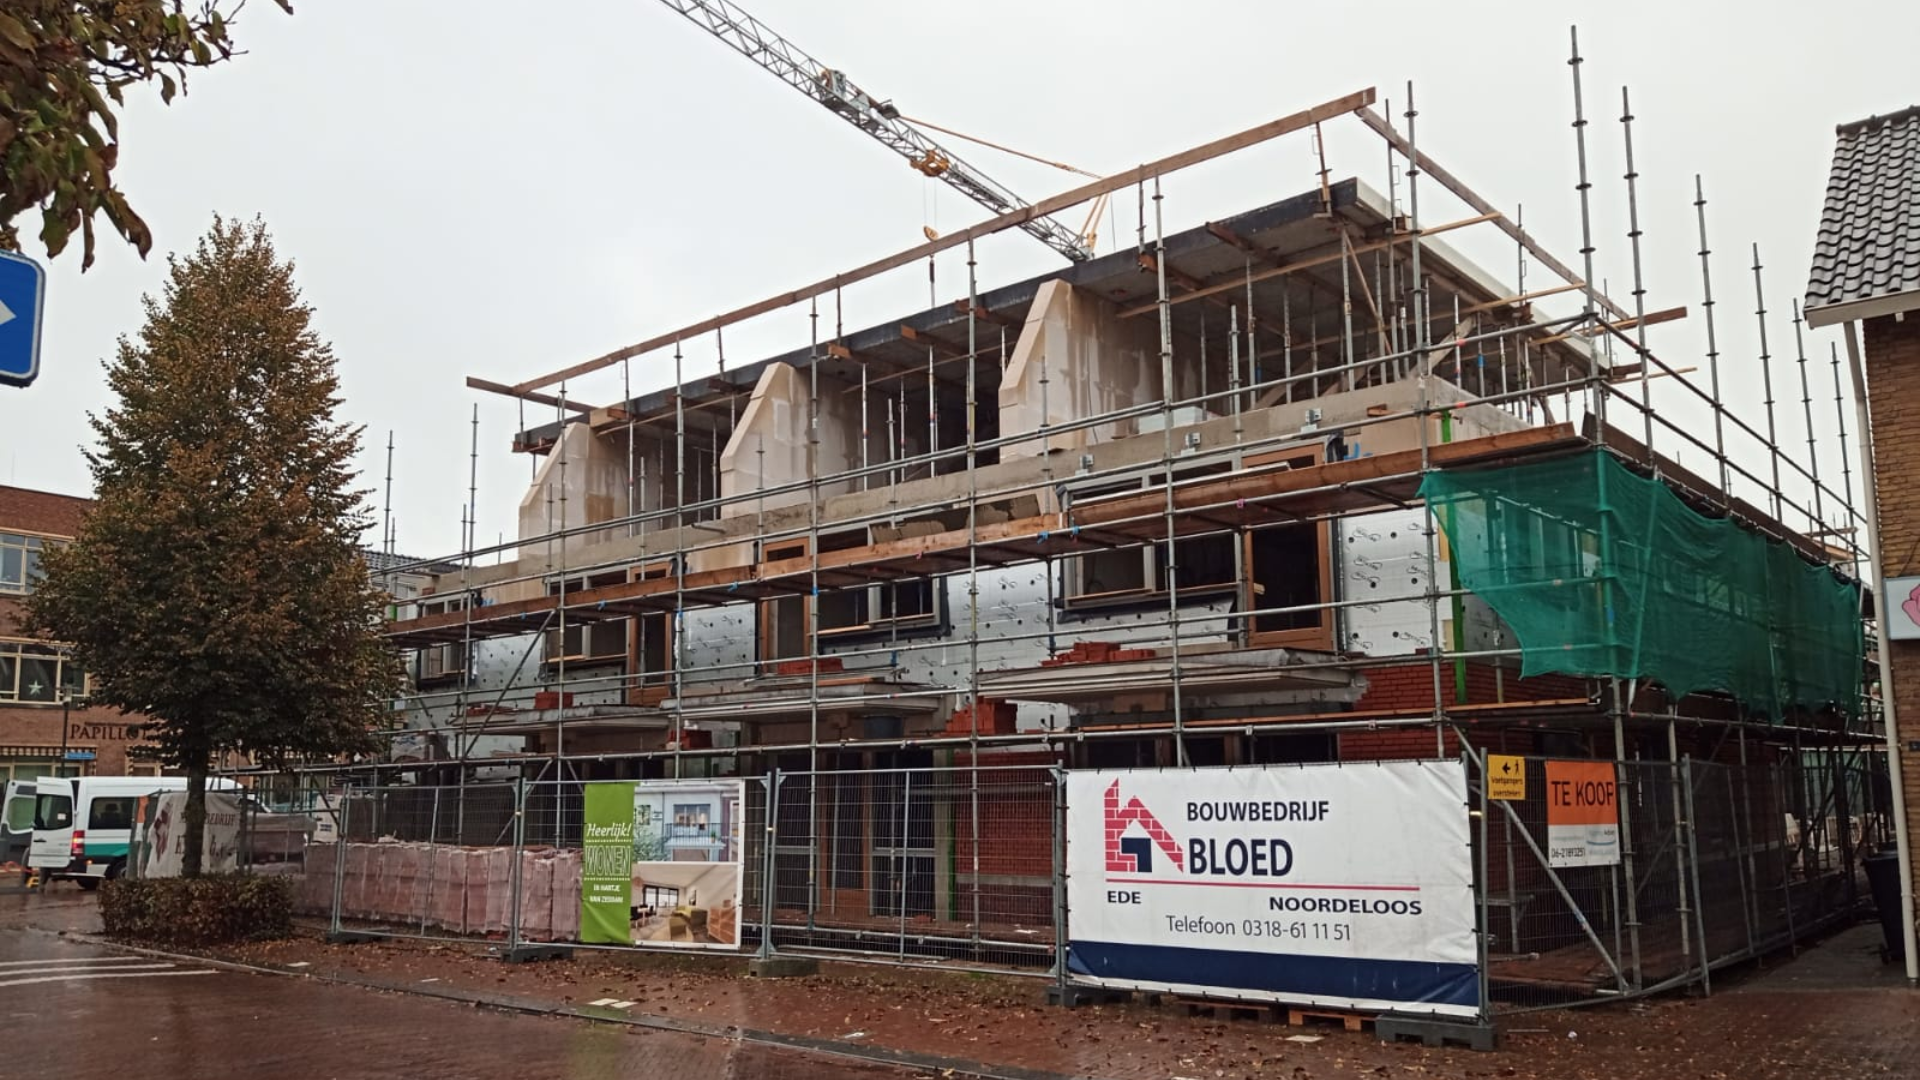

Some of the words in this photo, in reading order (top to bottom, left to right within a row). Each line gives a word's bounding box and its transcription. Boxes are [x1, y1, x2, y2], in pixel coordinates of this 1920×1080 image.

[69, 723, 149, 741] PAPILLO
[1551, 781, 1571, 806] TE
[1187, 801, 1329, 822] BOUWBEDRIJF
[586, 822, 632, 842] Heerlijk!
[585, 845, 631, 877] WONEN
[1188, 838, 1293, 877] BLOED
[1107, 890, 1141, 904] EDE
[1269, 896, 1422, 915] NOORDELOOS
[1165, 914, 1236, 936] Telefoon
[1242, 919, 1307, 939] 0318-61
[1334, 923, 1351, 941] 51
